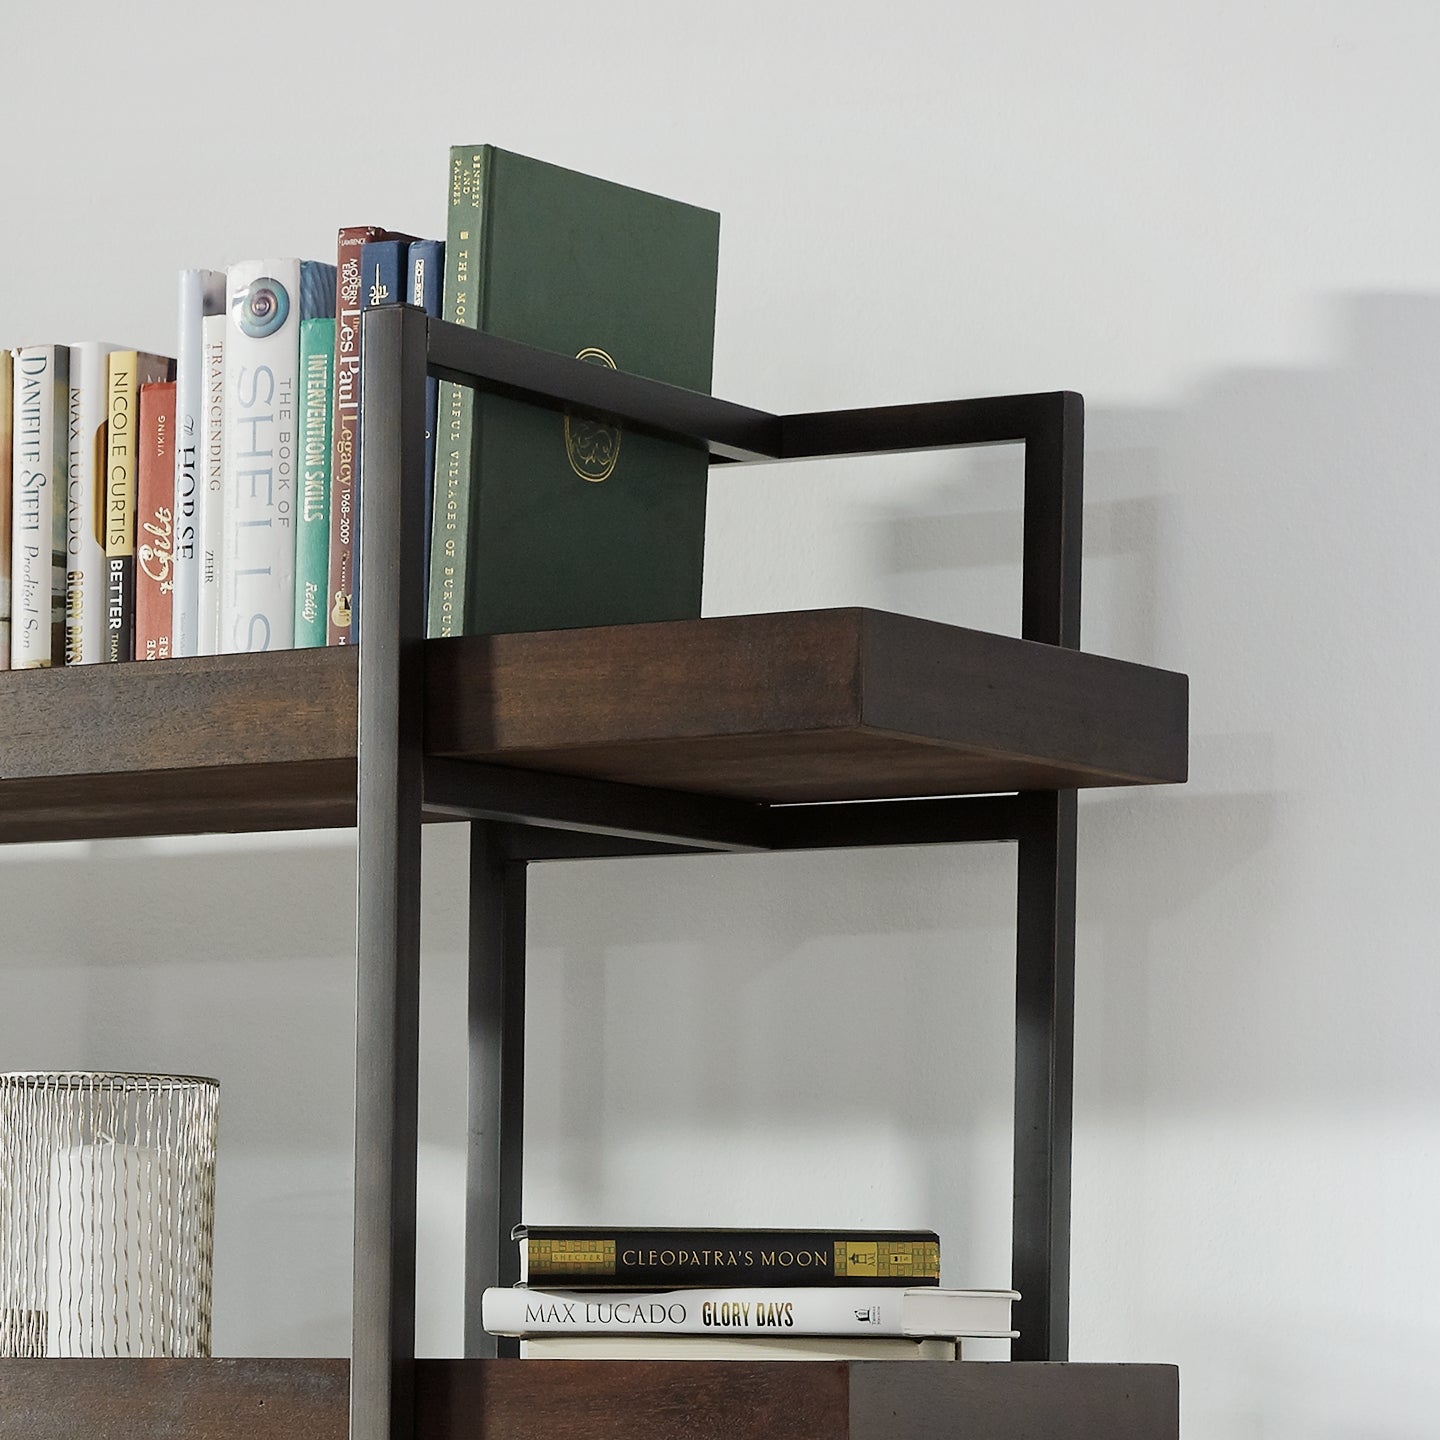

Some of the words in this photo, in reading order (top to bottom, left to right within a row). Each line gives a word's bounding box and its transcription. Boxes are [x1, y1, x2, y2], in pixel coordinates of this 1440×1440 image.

[472, 154, 481, 208] BENTLEY
[341, 263, 350, 284] ERA
[349, 258, 358, 305] MODERN
[458, 250, 467, 282] THE
[340, 309, 362, 353] Les
[456, 292, 466, 324] MOS
[22, 355, 47, 462] DANIELLE
[279, 378, 291, 420] THE
[338, 355, 360, 411] Paul
[70, 388, 80, 440] MAX
[112, 372, 128, 456] NICOLE
[157, 415, 166, 456] VIKING
[209, 341, 223, 491] TRANSCENDING
[305, 354, 327, 466] INTERVENTION
[278, 432, 290, 490] BOOK
[336, 415, 357, 486] Legacy
[21, 471, 46, 530] STEEL
[68, 452, 83, 555] LUCADO
[110, 466, 127, 545] CURTIS
[233, 365, 274, 651] SHELLS
[278, 501, 289, 527] OF
[303, 471, 325, 522] SKILLS
[446, 450, 459, 530] VILLAGES
[139, 506, 174, 582] Gilt
[205, 550, 214, 583] ZEHR
[445, 540, 455, 557] OF
[23, 545, 39, 613] Prodigal
[67, 571, 84, 619] GLORY
[110, 560, 124, 630] BETTER
[441, 568, 455, 637] BURGUN
[23, 618, 39, 648] Son
[65, 626, 84, 664] DAYS
[110, 633, 120, 662] THAN
[622, 1250, 754, 1266] CLEOPATRA'S
[761, 1251, 828, 1266] MOON
[525, 1304, 576, 1323] MAX
[586, 1303, 687, 1324] LUCADO
[702, 1301, 750, 1326] GLORY
[756, 1302, 794, 1327] DAYS
